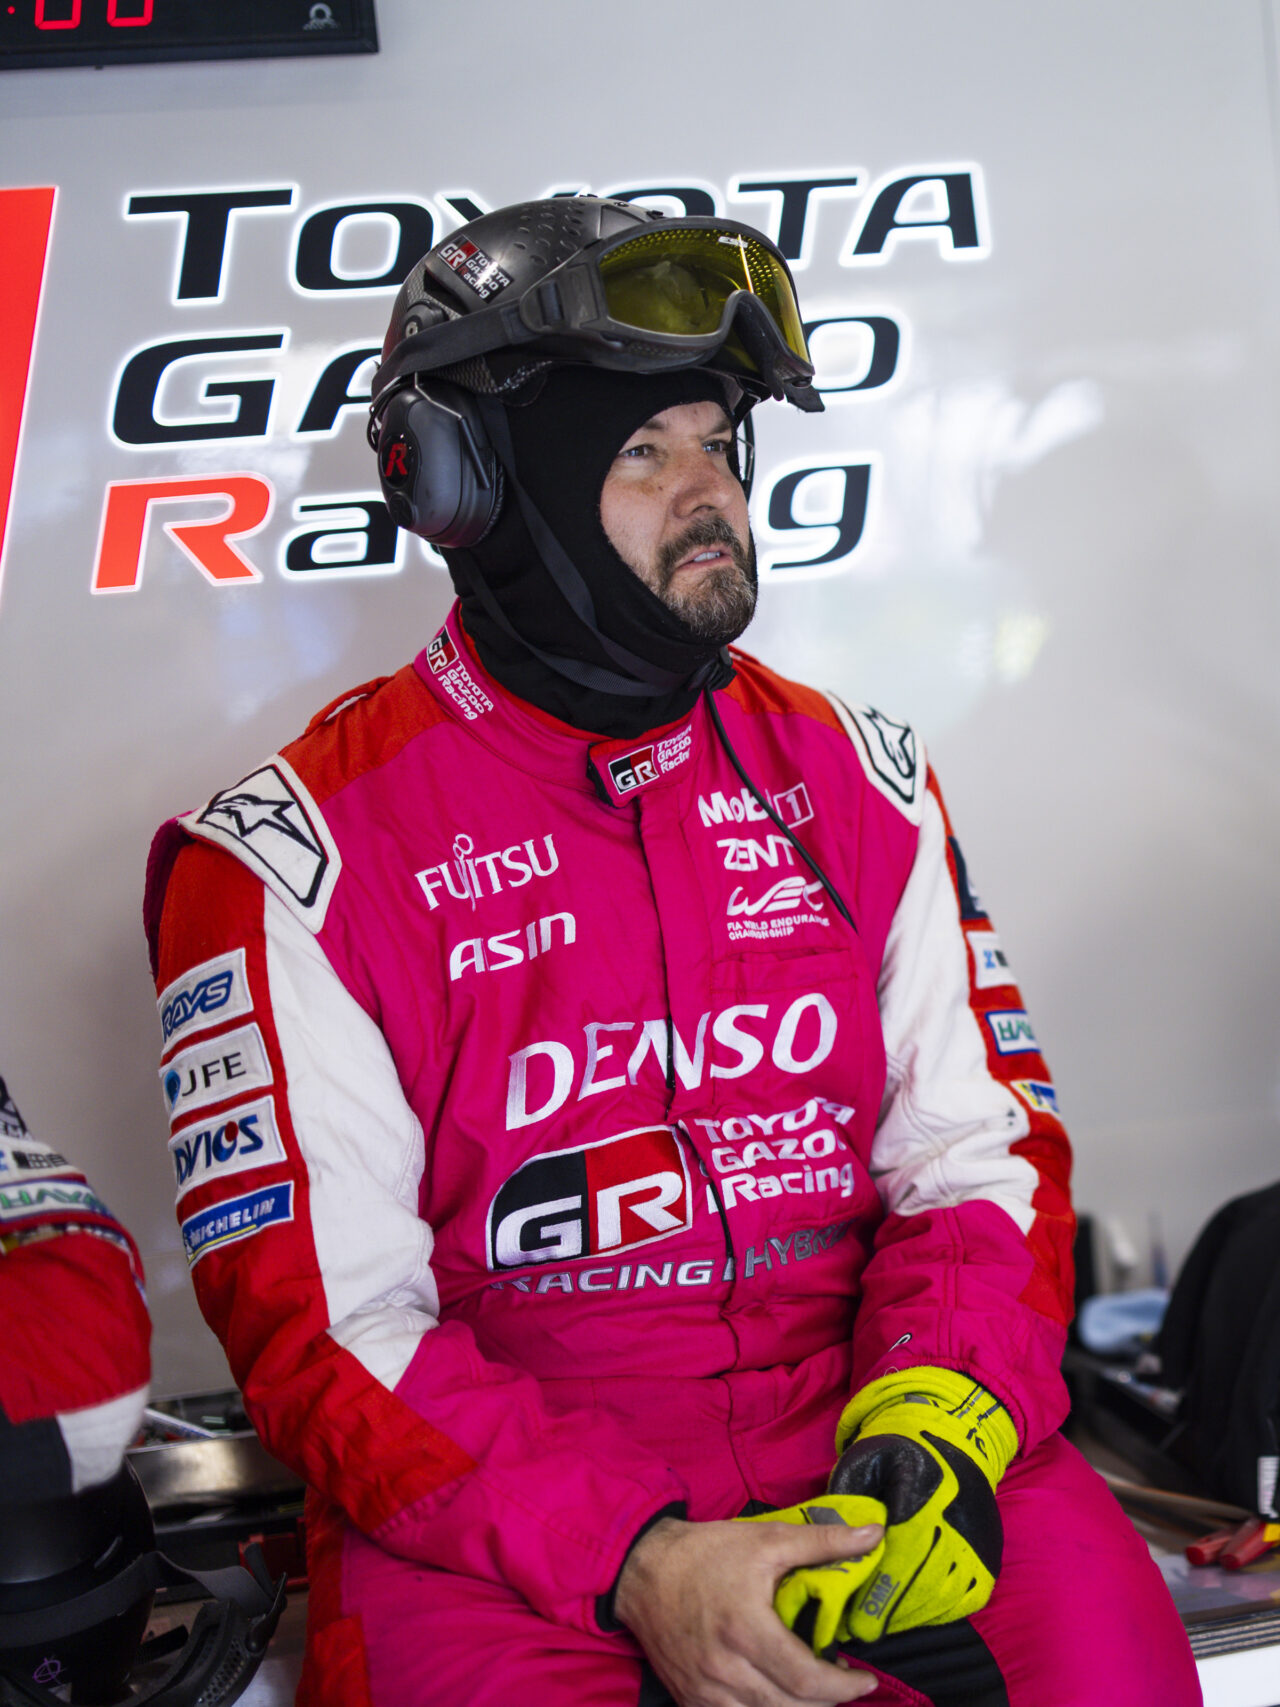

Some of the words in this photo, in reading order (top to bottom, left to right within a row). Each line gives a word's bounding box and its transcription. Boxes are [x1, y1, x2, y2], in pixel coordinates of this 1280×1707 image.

[441, 243, 467, 267] GR
[385, 443, 408, 477] R
[428, 637, 448, 671] GR
[437, 674, 478, 721] Racing
[446, 666, 485, 715] GAZOO
[458, 660, 494, 712] TOYOTA
[657, 736, 692, 763] GAZOO
[660, 747, 690, 774] Racin
[615, 760, 658, 789] GR
[414, 833, 559, 912] FUJITSU
[716, 833, 795, 872] ZENT
[450, 911, 577, 981] ASIN
[727, 921, 743, 931] FIA
[162, 970, 233, 1043] RAYS
[182, 1052, 246, 1098] JFE
[505, 992, 838, 1131] DENSO
[706, 1162, 855, 1215] Racing
[494, 1169, 687, 1267] GR
[864, 1574, 893, 1617] OMP
